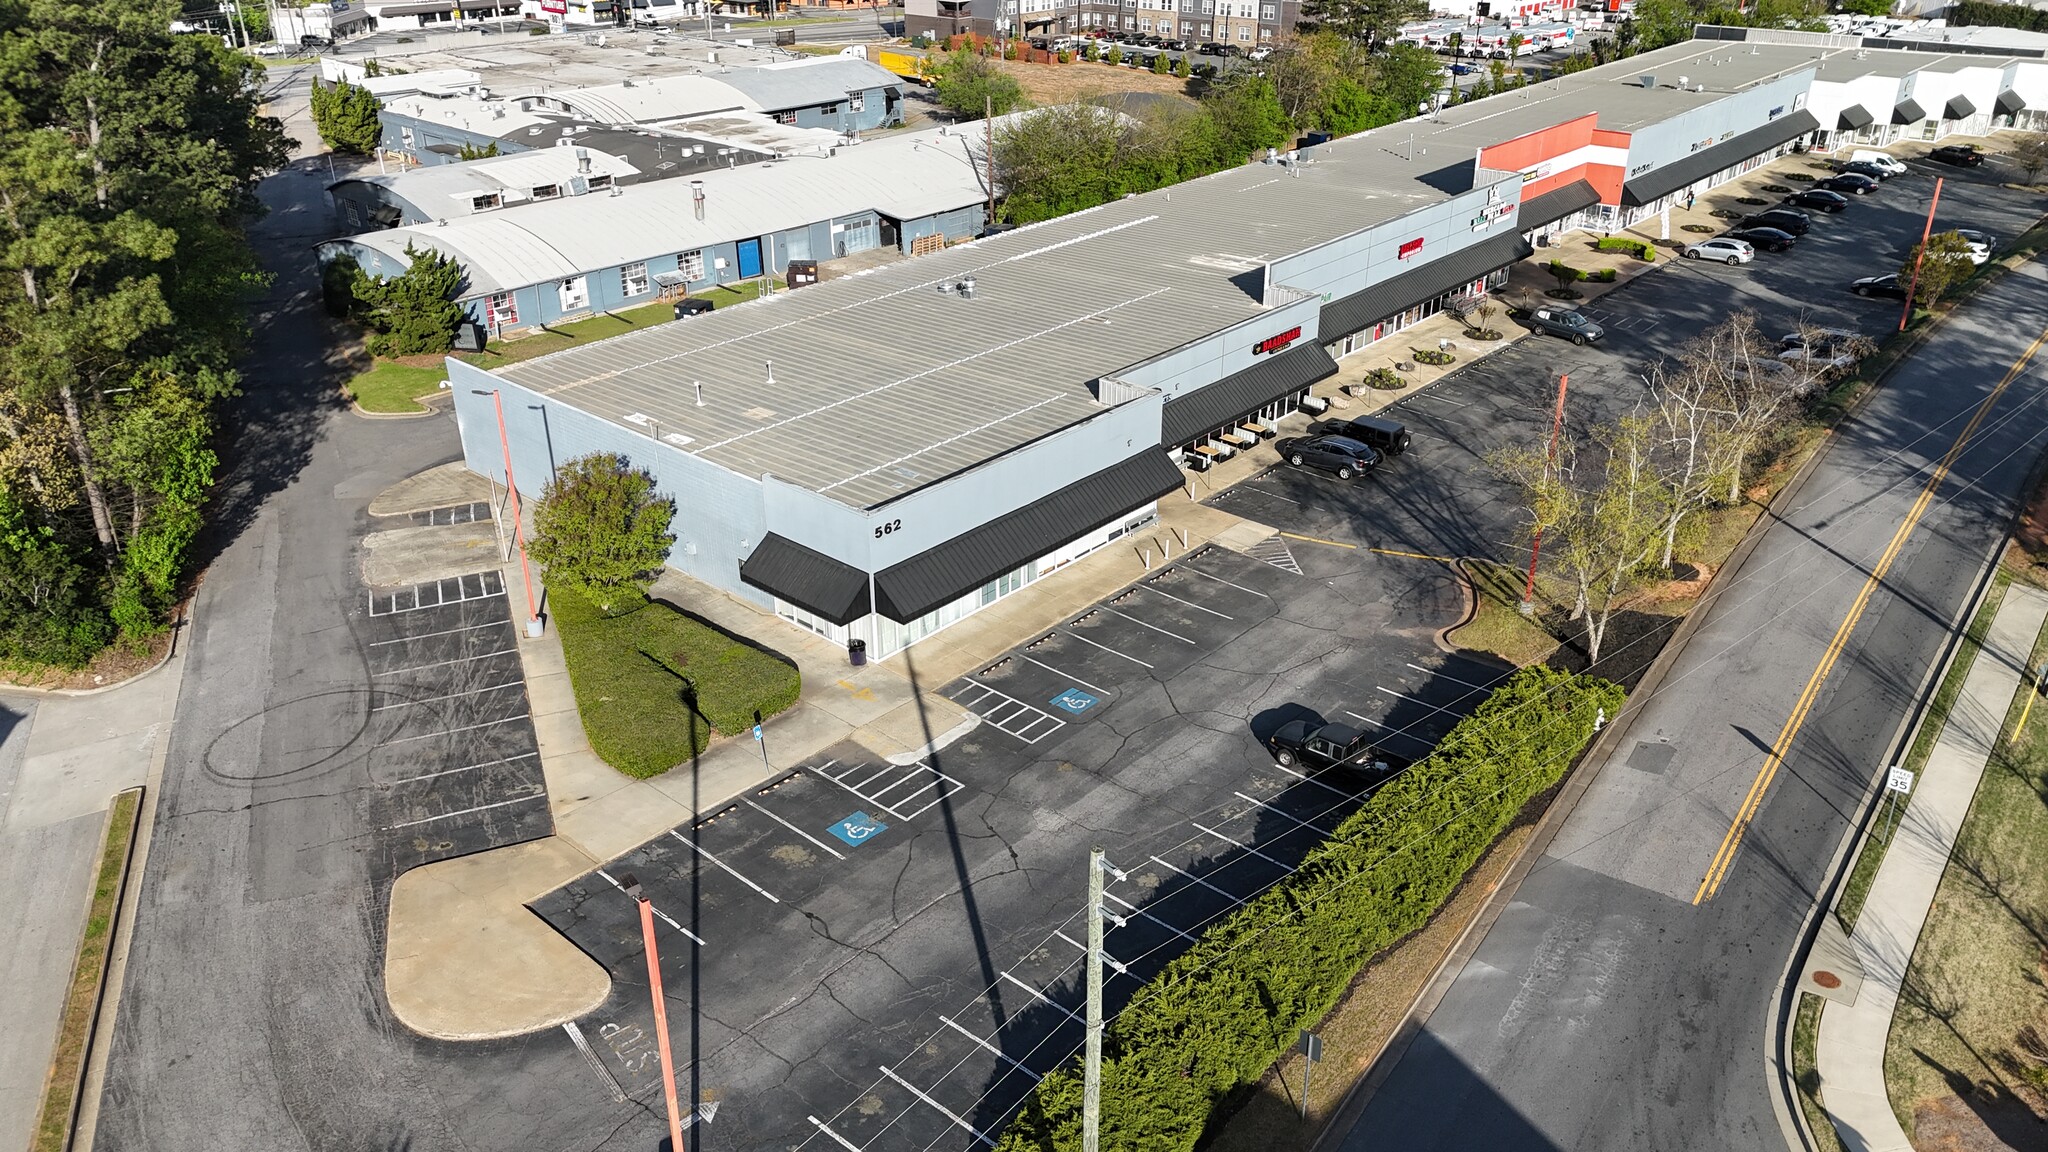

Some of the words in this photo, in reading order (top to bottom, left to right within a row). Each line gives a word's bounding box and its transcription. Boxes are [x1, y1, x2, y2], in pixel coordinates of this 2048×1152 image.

[1262, 328, 1301, 353] BAADSHAH
[874, 518, 902, 539] 562
[1892, 769, 1912, 778] SPEED
[1890, 778, 1908, 790] 35
